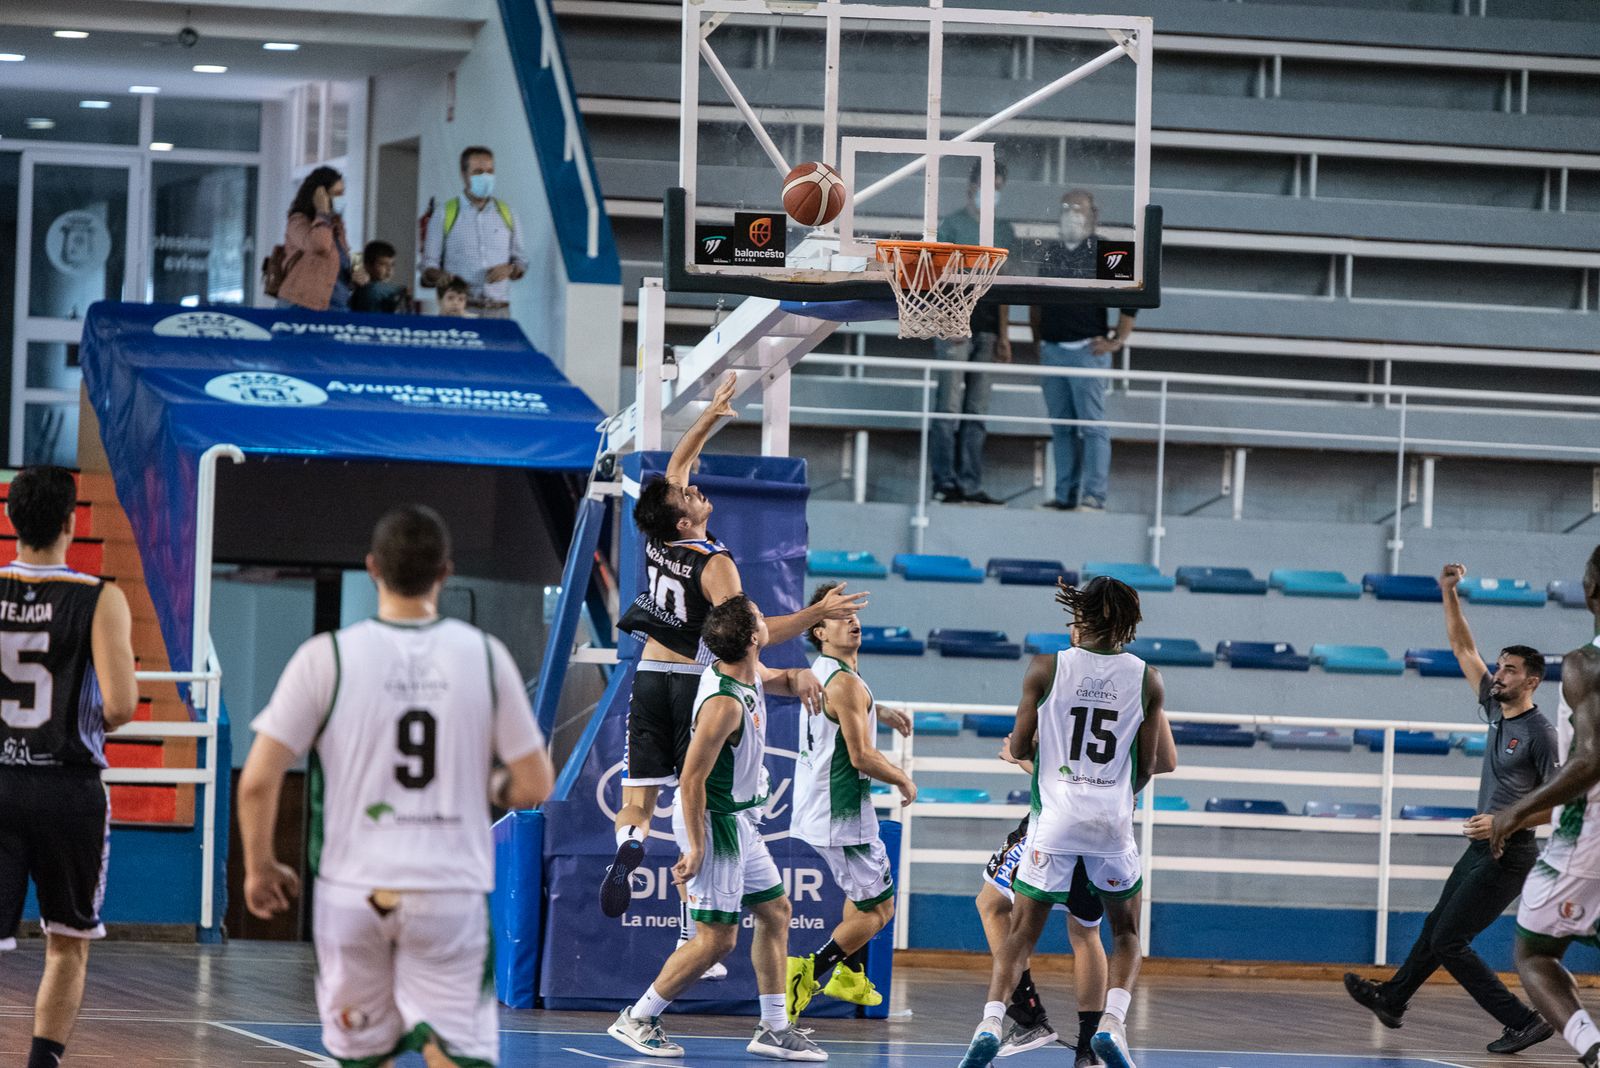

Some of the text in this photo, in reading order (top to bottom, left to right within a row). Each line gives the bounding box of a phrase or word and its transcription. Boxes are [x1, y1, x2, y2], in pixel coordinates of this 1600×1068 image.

[734, 248, 785, 259] baloncesto
[270, 321, 480, 340] Ayuntamiento
[326, 380, 543, 400] Ayuntamiento
[391, 393, 548, 408] de Huelva
[0, 601, 53, 623] TEJADA
[0, 631, 53, 728] 5
[1069, 706, 1119, 765] 15
[395, 709, 437, 789] 9
[621, 913, 642, 927] La
